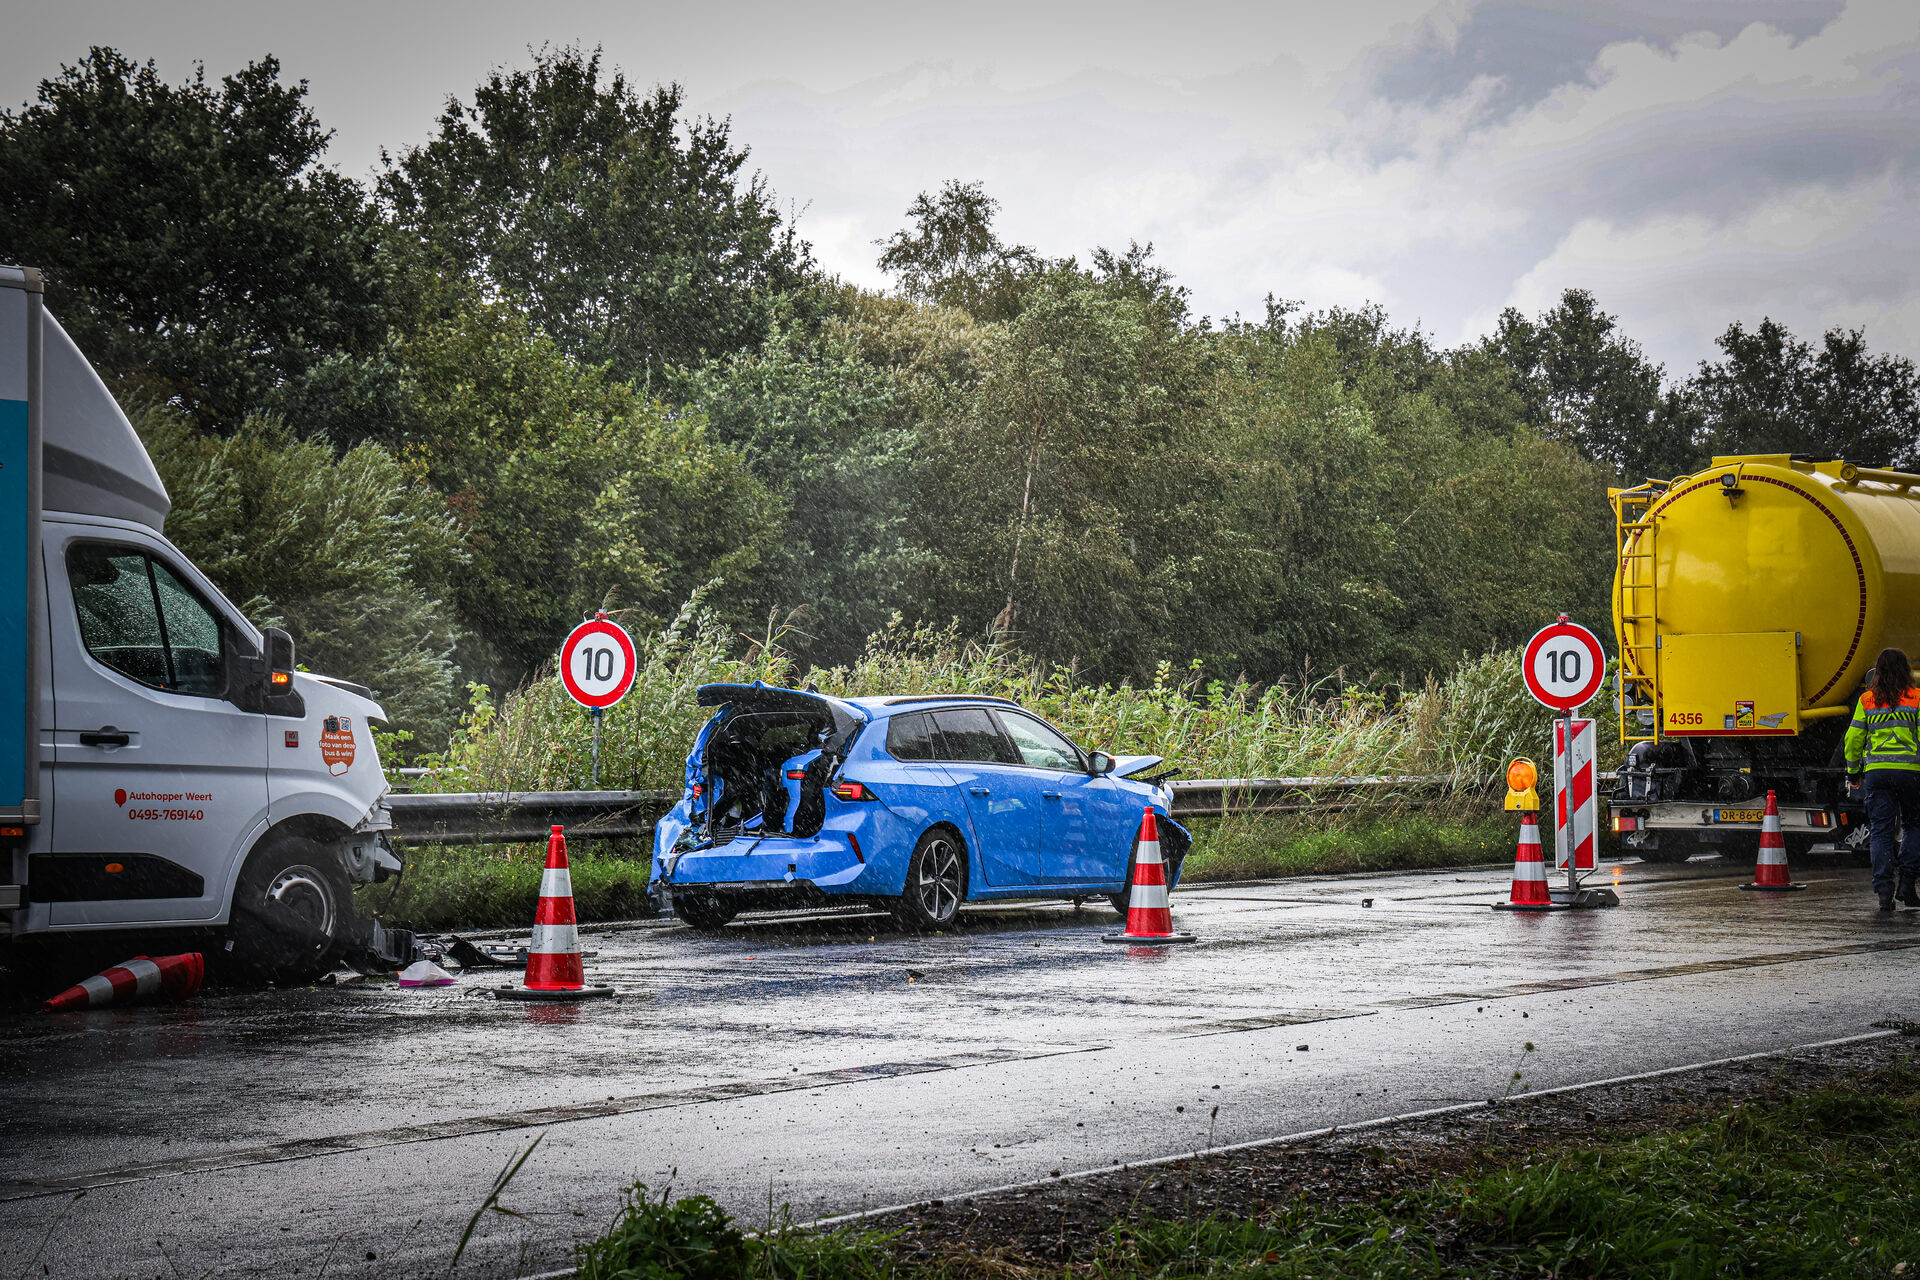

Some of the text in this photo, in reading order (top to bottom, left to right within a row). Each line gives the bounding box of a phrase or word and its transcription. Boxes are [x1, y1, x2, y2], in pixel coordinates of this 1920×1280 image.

[582, 647, 614, 681] 10
[1546, 650, 1581, 683] 10
[1669, 712, 1703, 725] 4356
[129, 791, 213, 803] Autohopper Weert
[128, 809, 204, 821] 0495-769140
[1721, 810, 1764, 820] OR-86-G
